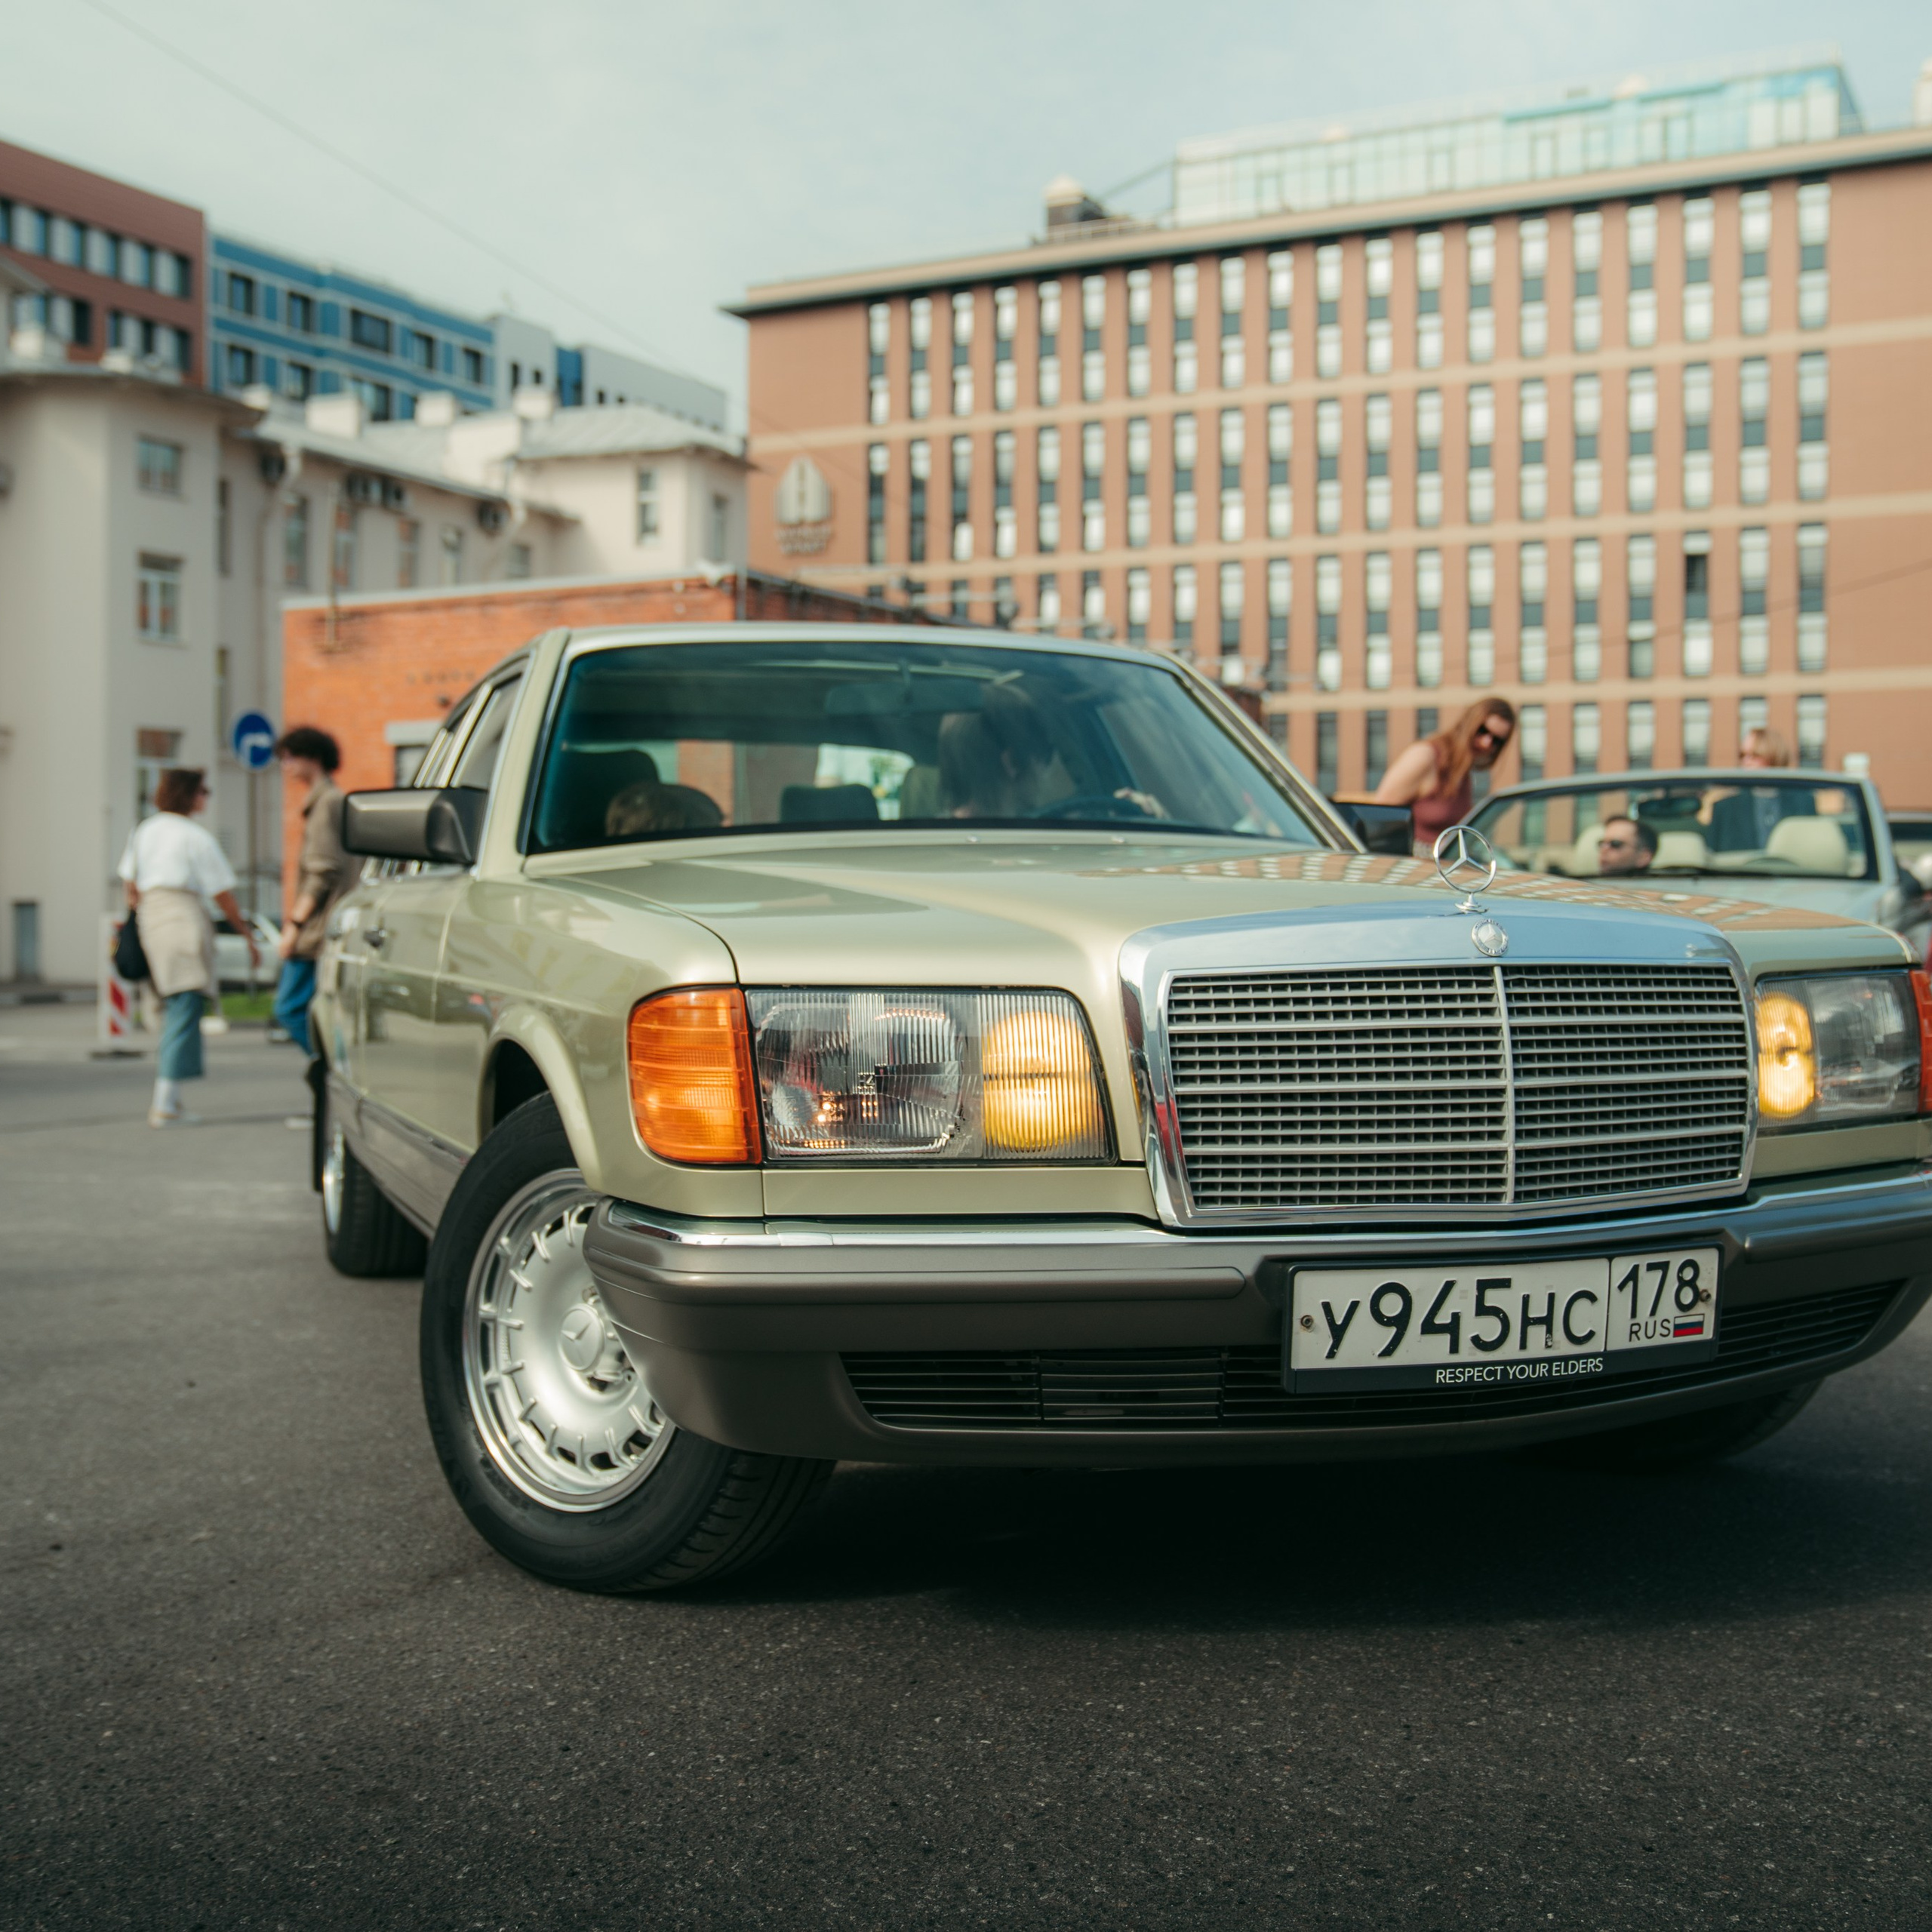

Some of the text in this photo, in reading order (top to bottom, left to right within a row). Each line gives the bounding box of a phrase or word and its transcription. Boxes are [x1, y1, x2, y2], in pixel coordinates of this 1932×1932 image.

[1617, 1258, 1700, 1319] 178
[1629, 1318, 1671, 1343] RUS
[1435, 1358, 1603, 1383] RESPECT YOUR ELDERS
